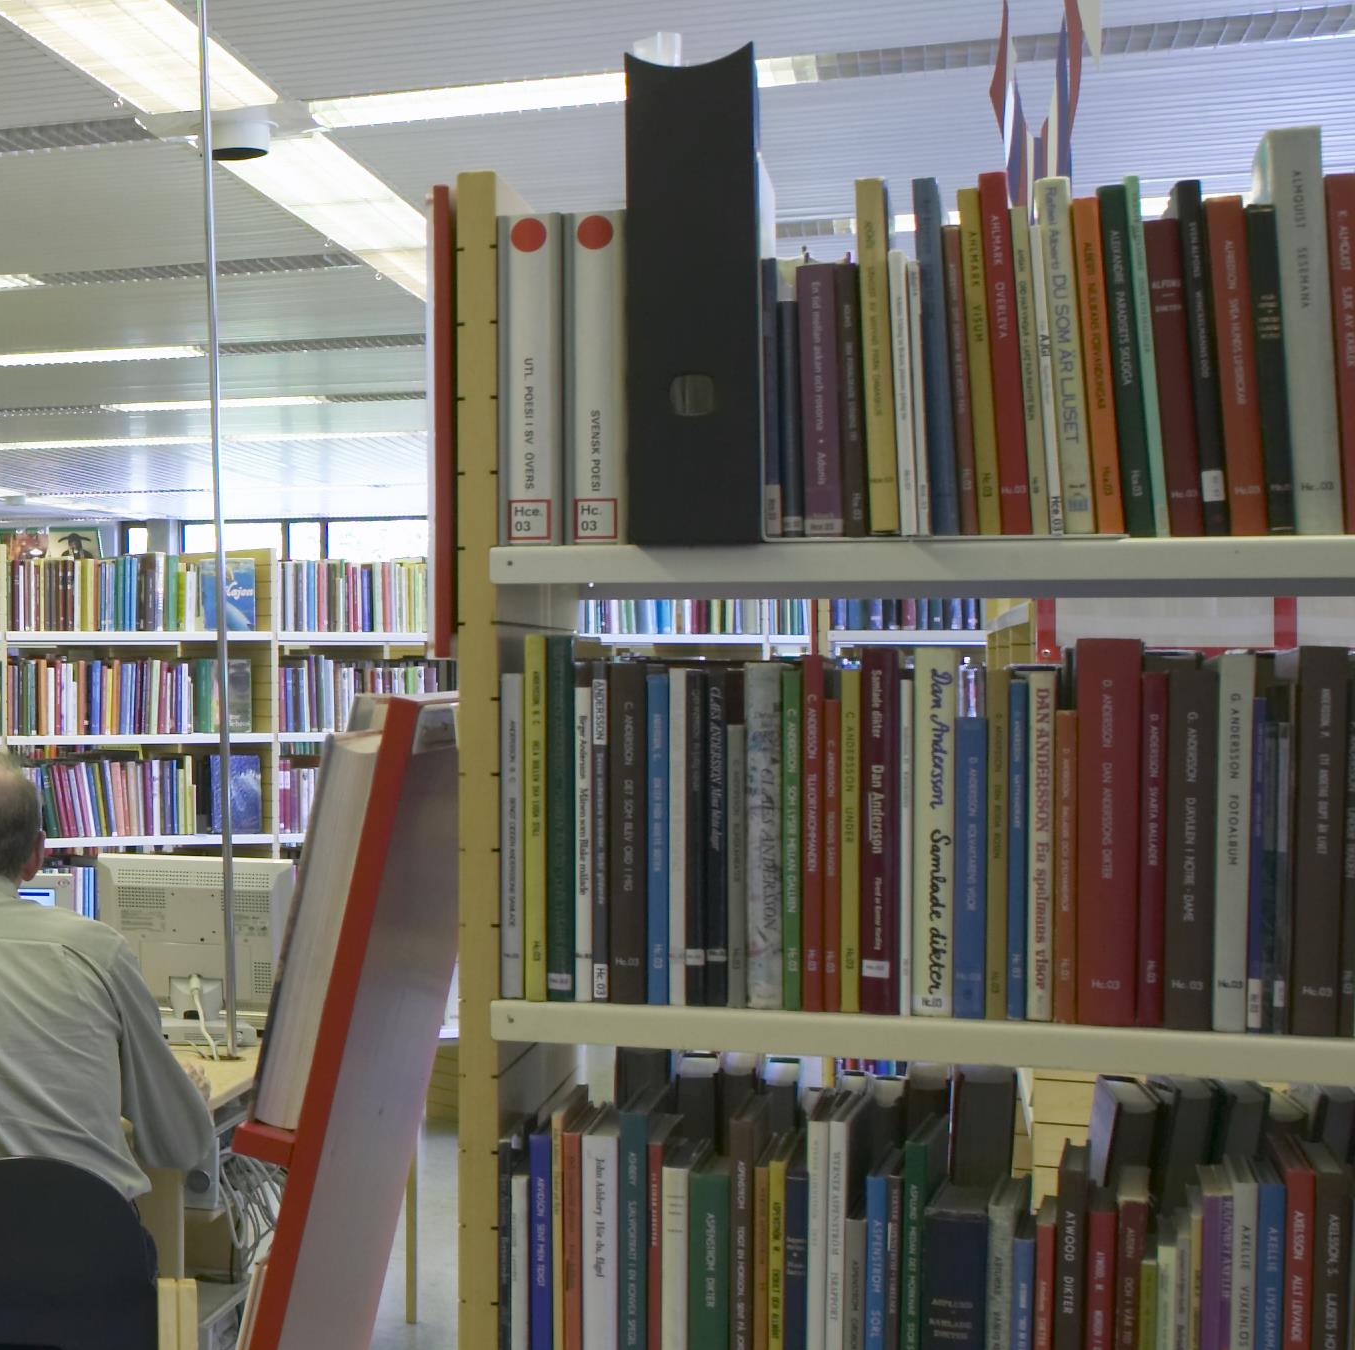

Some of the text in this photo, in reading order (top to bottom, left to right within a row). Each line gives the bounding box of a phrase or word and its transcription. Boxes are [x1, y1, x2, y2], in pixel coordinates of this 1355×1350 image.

[969, 231, 980, 286] AHLMARK
[991, 215, 1003, 265] AHLMARK
[1296, 248, 1310, 309] SESEMANA
[1044, 187, 1079, 444] Rafael Alberti DU SOM ÄR LJUSET
[811, 281, 827, 485] En tid mellan askan och rosorna Adonis
[1120, 347, 1132, 385] SKUGGA
[524, 386, 534, 418] POESI
[590, 410, 601, 492] SVENSK POESI
[514, 507, 543, 516] Hce.
[515, 522, 531, 531] 03
[581, 505, 602, 515] Hc.
[581, 521, 597, 531] 03
[1051, 496, 1062, 533] Hce.03
[595, 682, 605, 740] ANDERSSON
[709, 687, 722, 717] CLAES
[870, 670, 884, 738] Samlade dikter
[1101, 695, 1113, 747] ANDERSSON
[709, 720, 722, 784] ANDERSSON
[786, 721, 797, 773] ANDERSSON
[806, 708, 818, 759] ANDERSSON
[845, 726, 855, 792] ANDERSSON
[1229, 708, 1240, 779] ANDERSSON
[787, 786, 797, 805] SOM
[1102, 762, 1113, 783] DAN
[578, 788, 589, 816] Månen
[579, 818, 587, 836] som
[787, 809, 797, 834] LYSER
[845, 807, 855, 843] UNDER
[870, 765, 885, 854] Dan Andersson
[1101, 787, 1112, 845] ANDERSSONS
[578, 839, 589, 861] Blake
[760, 768, 778, 930] CLAES ANDERSSON
[787, 838, 797, 871] MELLAN
[928, 668, 952, 995] Dan Andersson Samlade dikter
[1033, 688, 1050, 990] DAN ANDERSSON En spelmans visor
[1228, 795, 1240, 865] FOTOALBUM
[579, 864, 589, 895] målade
[1101, 849, 1112, 879] DIKTER
[596, 968, 606, 996] Hc.03
[592, 1158, 606, 1278] John Ashbery Hör du, fågel
[1062, 1212, 1076, 1314] ATWOOD DIKTER
[1266, 1227, 1278, 1272] AXELLIE
[1289, 1211, 1306, 1342] AXELSSON ALLT LEVANDE
